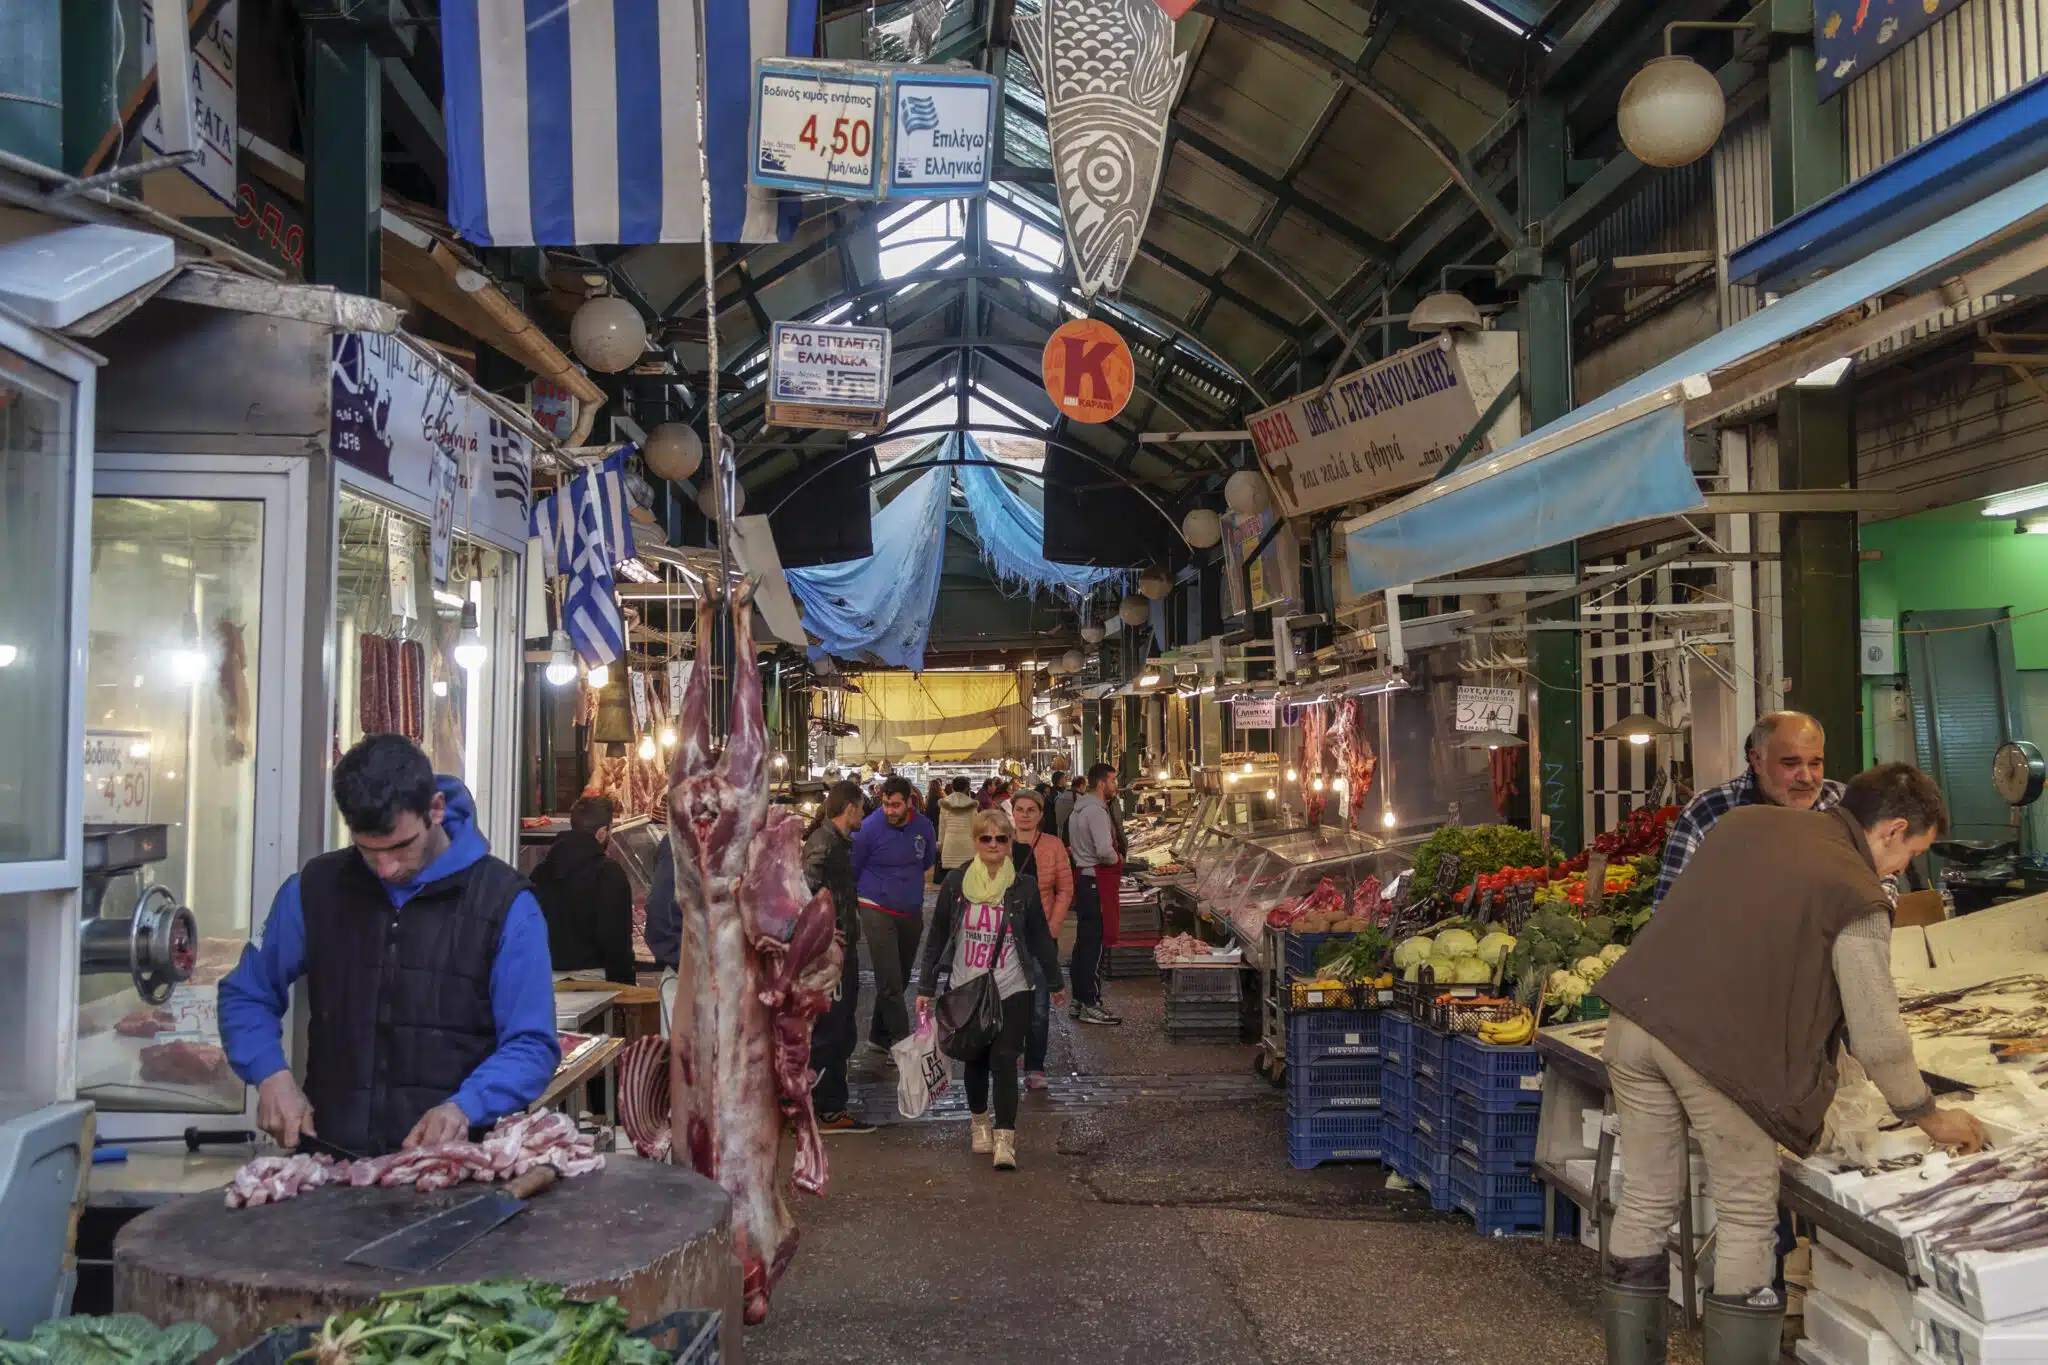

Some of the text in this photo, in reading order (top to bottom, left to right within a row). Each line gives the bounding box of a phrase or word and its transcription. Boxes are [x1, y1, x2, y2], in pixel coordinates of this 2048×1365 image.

[764, 85, 872, 108] Βοδινός κιμάς εντόπιος
[799, 114, 870, 157] 4,50
[933, 129, 984, 151] Επιλέγω
[827, 160, 869, 176] Τιμή/κιλό
[925, 154, 983, 179] Ελληνικά
[782, 333, 880, 351] ΕΔΩ ΕΠΙΛΕΓΩ
[798, 351, 868, 367] ΕΛΛΗΝΙΚΑ
[1252, 410, 1300, 455] ΚΡΕΑΤΑ
[1340, 347, 1458, 424] ΣΤΕΦΑΝΟΥΔΑΚΗΣ
[1300, 433, 1405, 489] και καλά & φθηνά
[1457, 702, 1514, 727] 3,49
